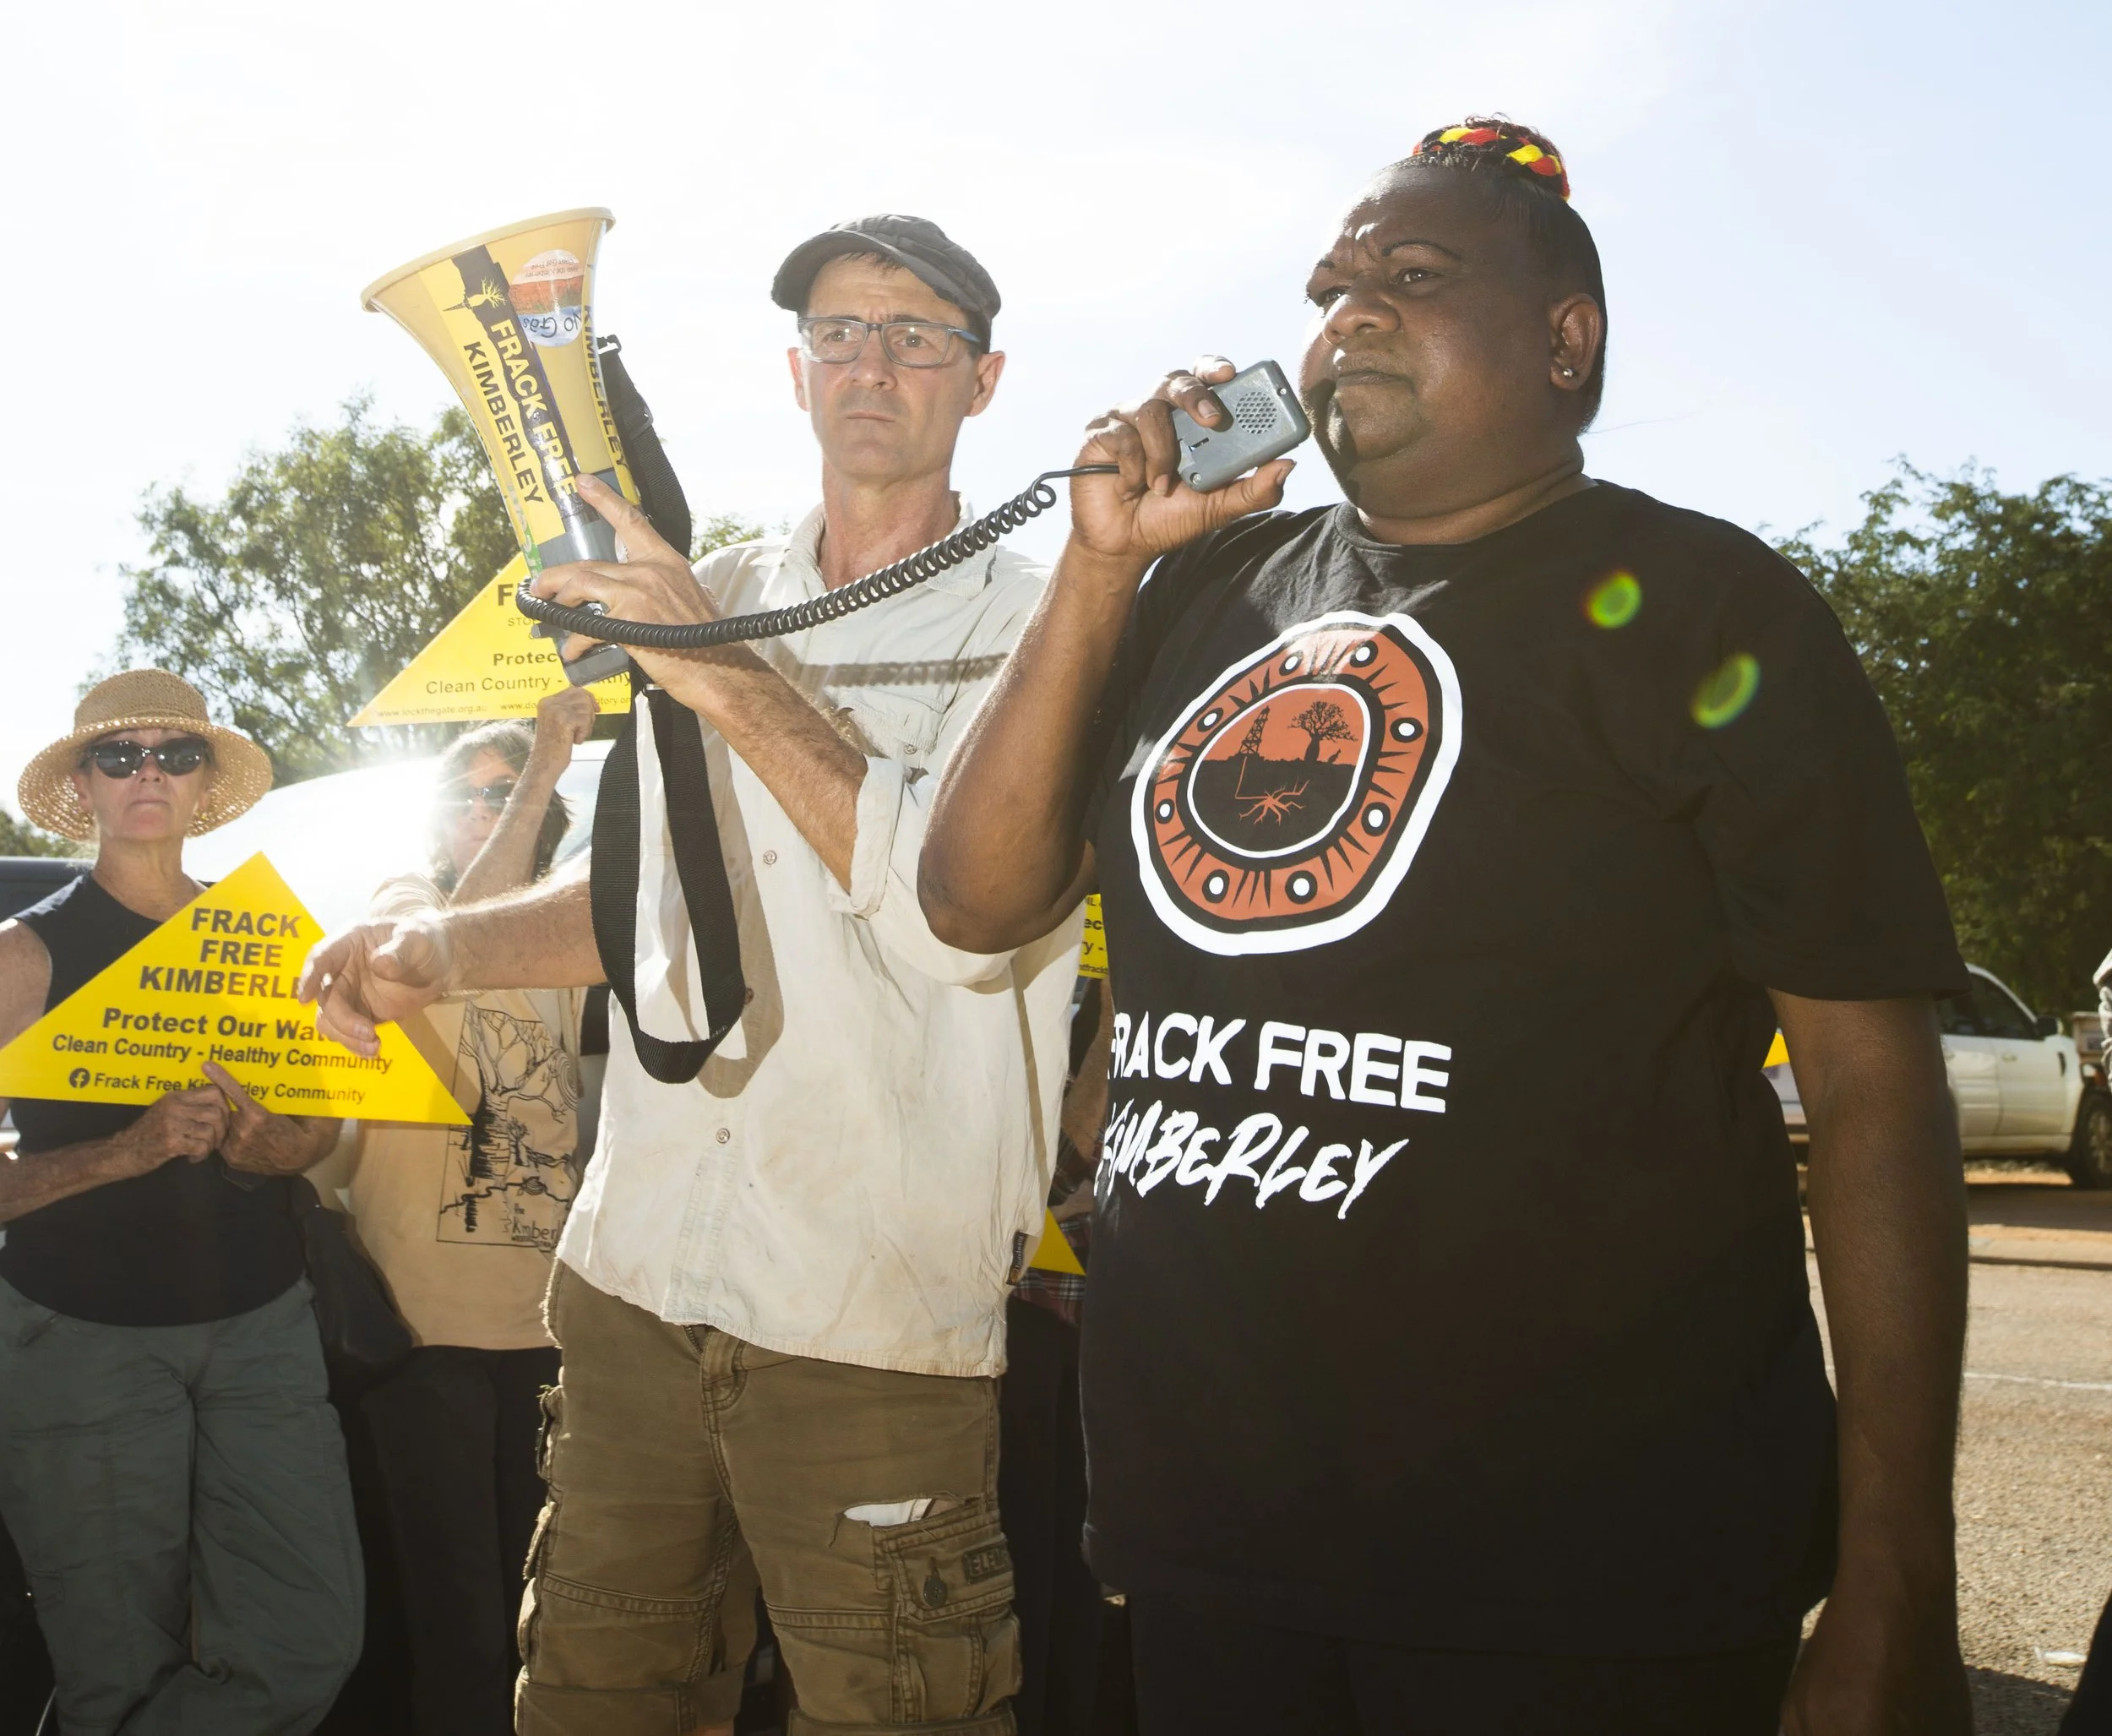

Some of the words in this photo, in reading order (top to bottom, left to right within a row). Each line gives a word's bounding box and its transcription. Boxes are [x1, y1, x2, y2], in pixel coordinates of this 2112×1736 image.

[522, 316, 558, 339] Gas
[463, 340, 543, 505] KIMBERLEY
[490, 318, 549, 419] FRACK
[534, 421, 580, 499] FREE
[493, 651, 558, 667] Protec
[426, 680, 476, 694] Clean
[482, 675, 551, 692] Country
[500, 700, 538, 710] www.do
[192, 907, 303, 939] FRACK
[199, 939, 285, 968] FREE
[139, 966, 299, 999] KIMBERL
[103, 1008, 207, 1037] Protect
[218, 1015, 267, 1039] Our
[52, 1034, 108, 1055] Clean
[114, 1037, 191, 1064] Country
[209, 1043, 280, 1069] Healthy
[286, 1048, 393, 1075] Community
[1254, 1020, 1452, 1113] FREE
[94, 1072, 142, 1091] Frack
[145, 1075, 182, 1092] Free
[275, 1082, 366, 1105] Community
